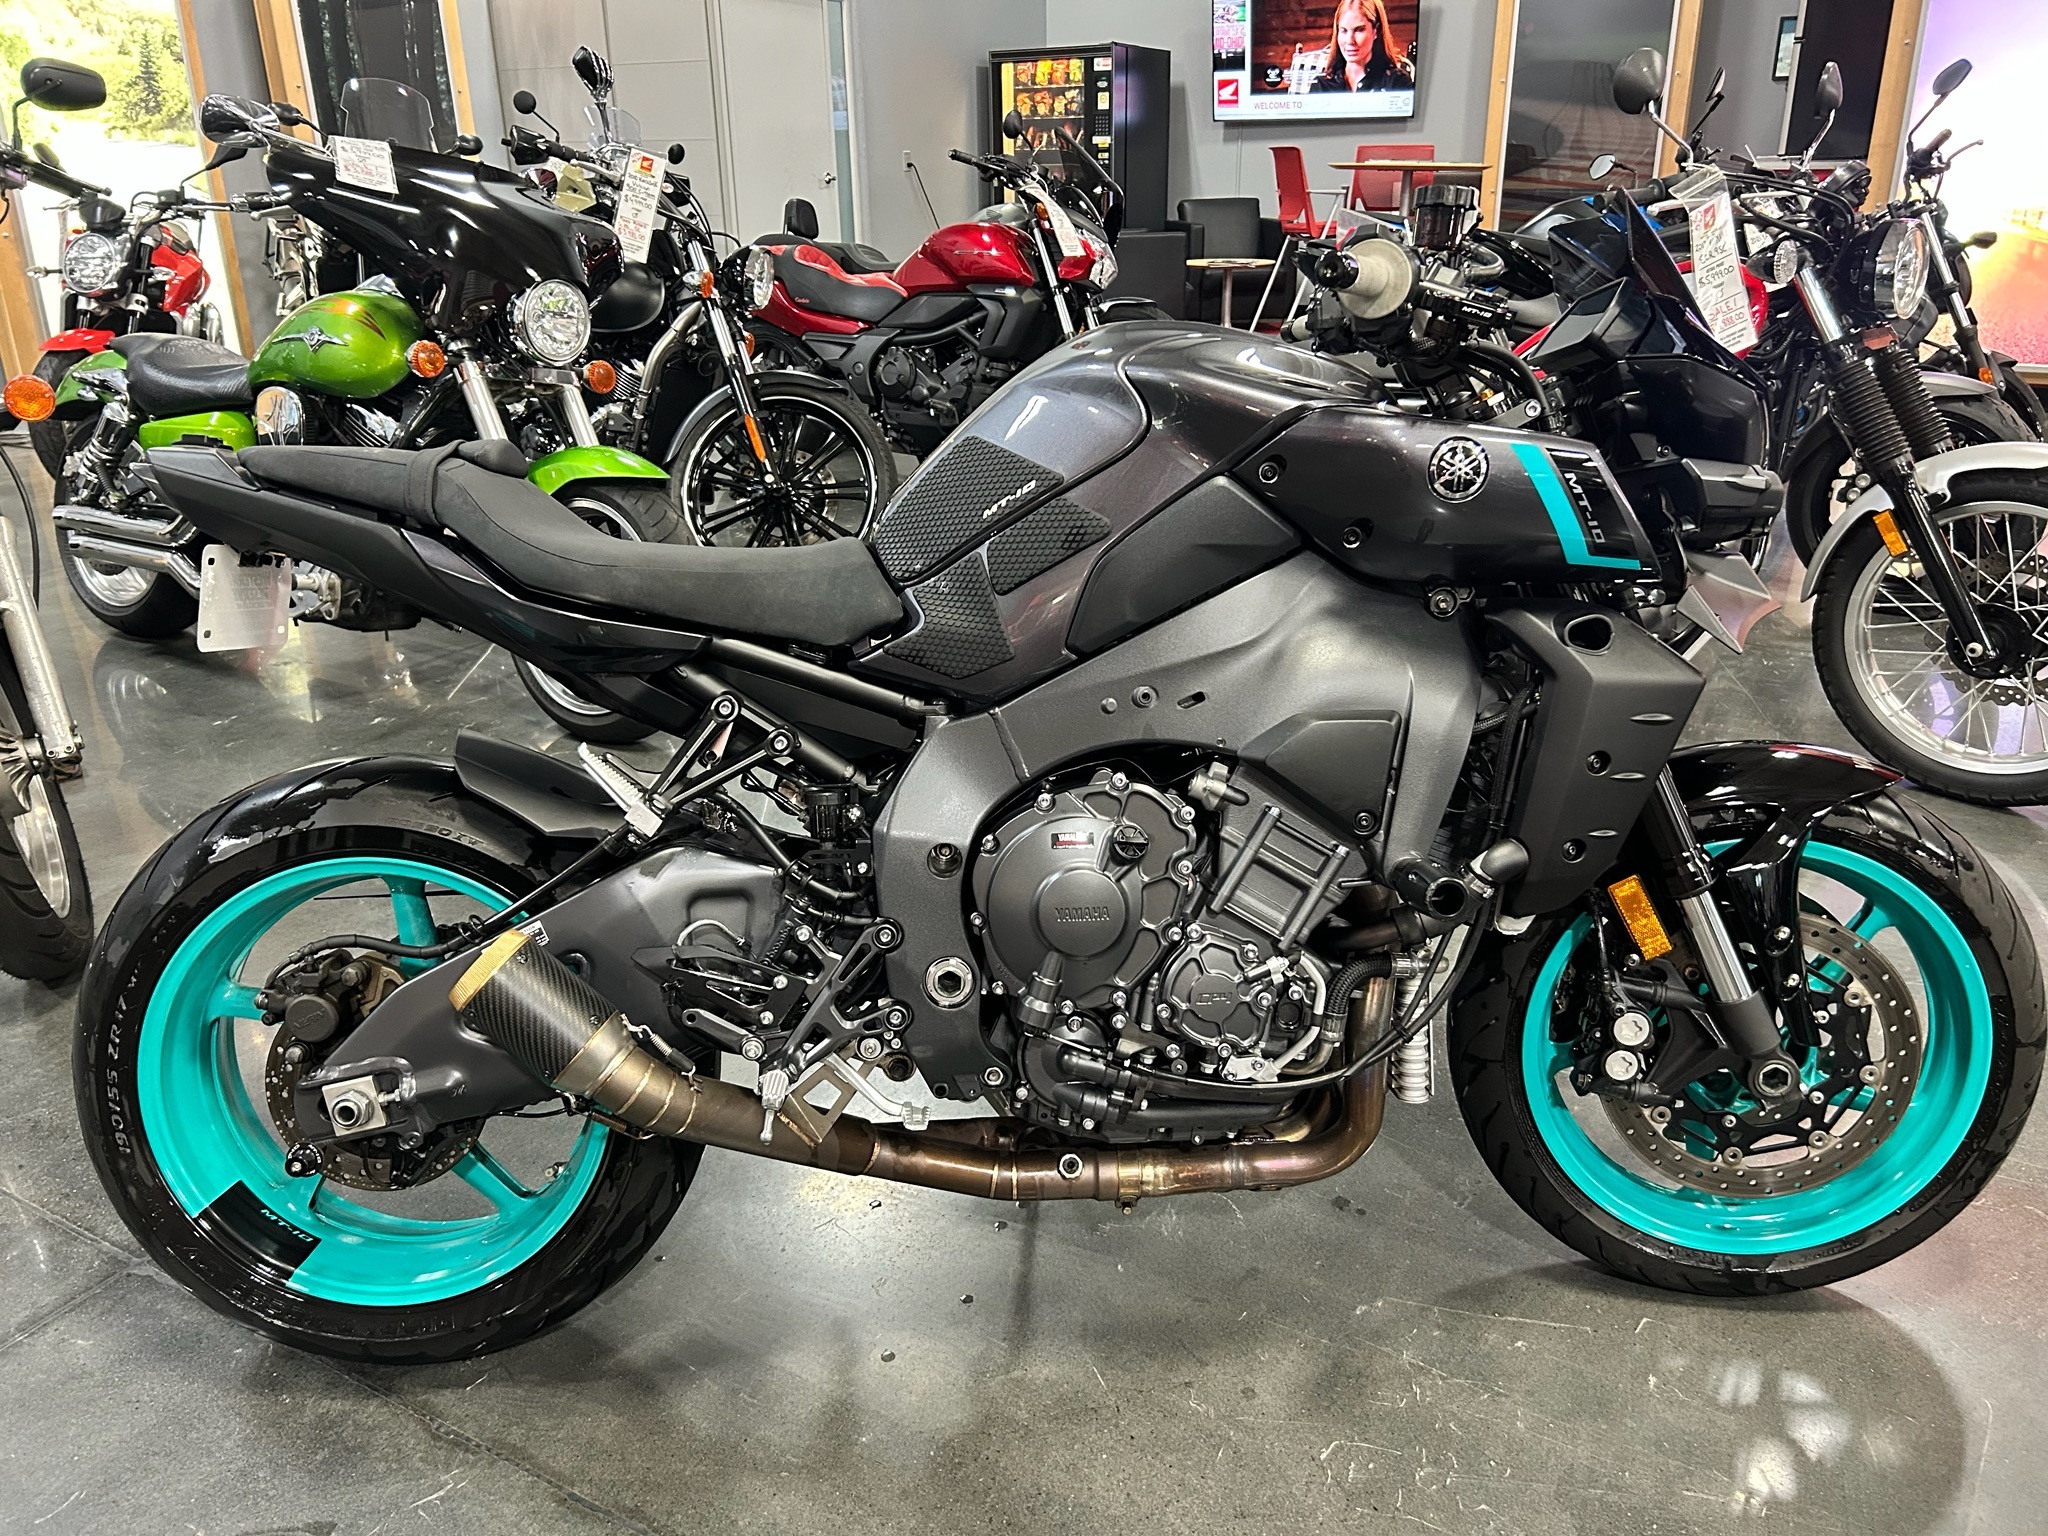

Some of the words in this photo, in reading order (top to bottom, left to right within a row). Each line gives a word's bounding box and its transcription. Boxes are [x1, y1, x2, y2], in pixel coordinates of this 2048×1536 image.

[1253, 101, 1291, 110] WELCOME
[1292, 101, 1303, 109] TO
[1461, 305, 1493, 319] MT-10
[982, 479, 1037, 519] MT-10
[1563, 472, 1606, 544] MT-10
[1055, 906, 1110, 922] YAMAHA
[106, 1068, 131, 1154] 190/55
[261, 1209, 314, 1242] MT-10
